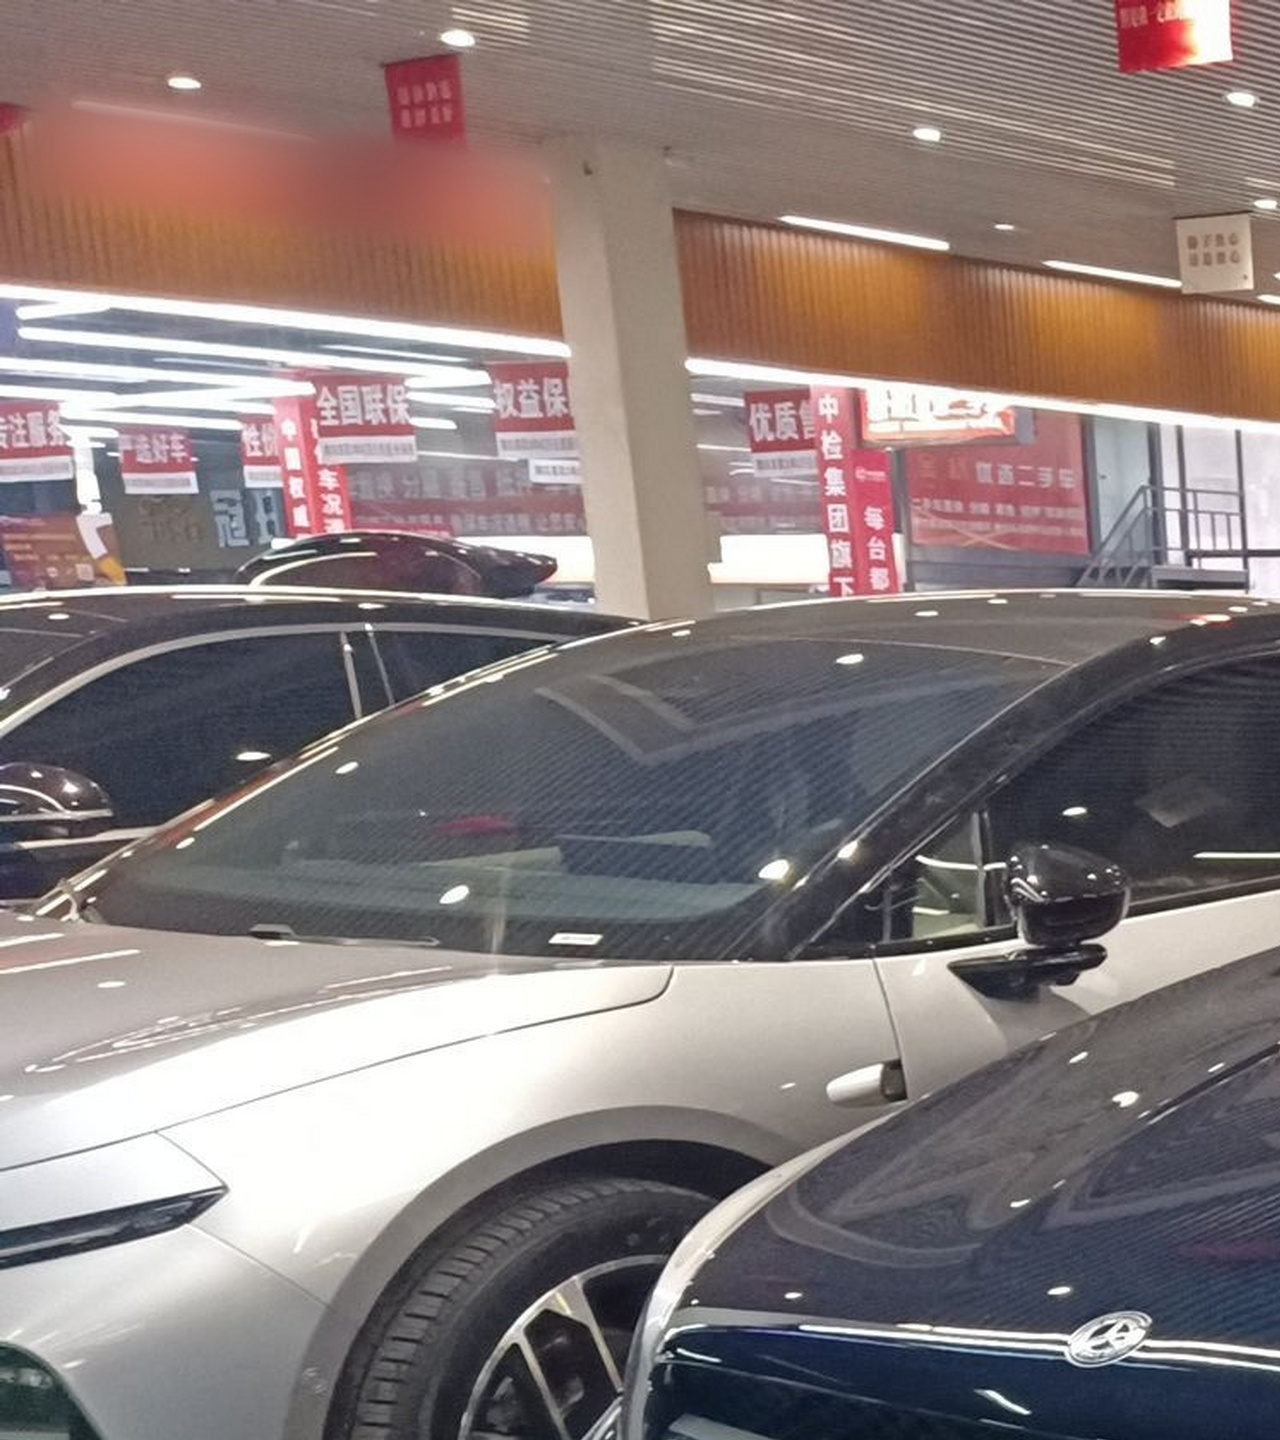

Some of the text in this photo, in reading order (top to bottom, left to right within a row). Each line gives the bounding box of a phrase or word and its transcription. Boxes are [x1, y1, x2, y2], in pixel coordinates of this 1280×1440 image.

[316, 383, 412, 427] 全国联保
[493, 378, 571, 419] 权益保
[818, 393, 855, 597] 中检集团旗下
[863, 506, 890, 591] 每台都
